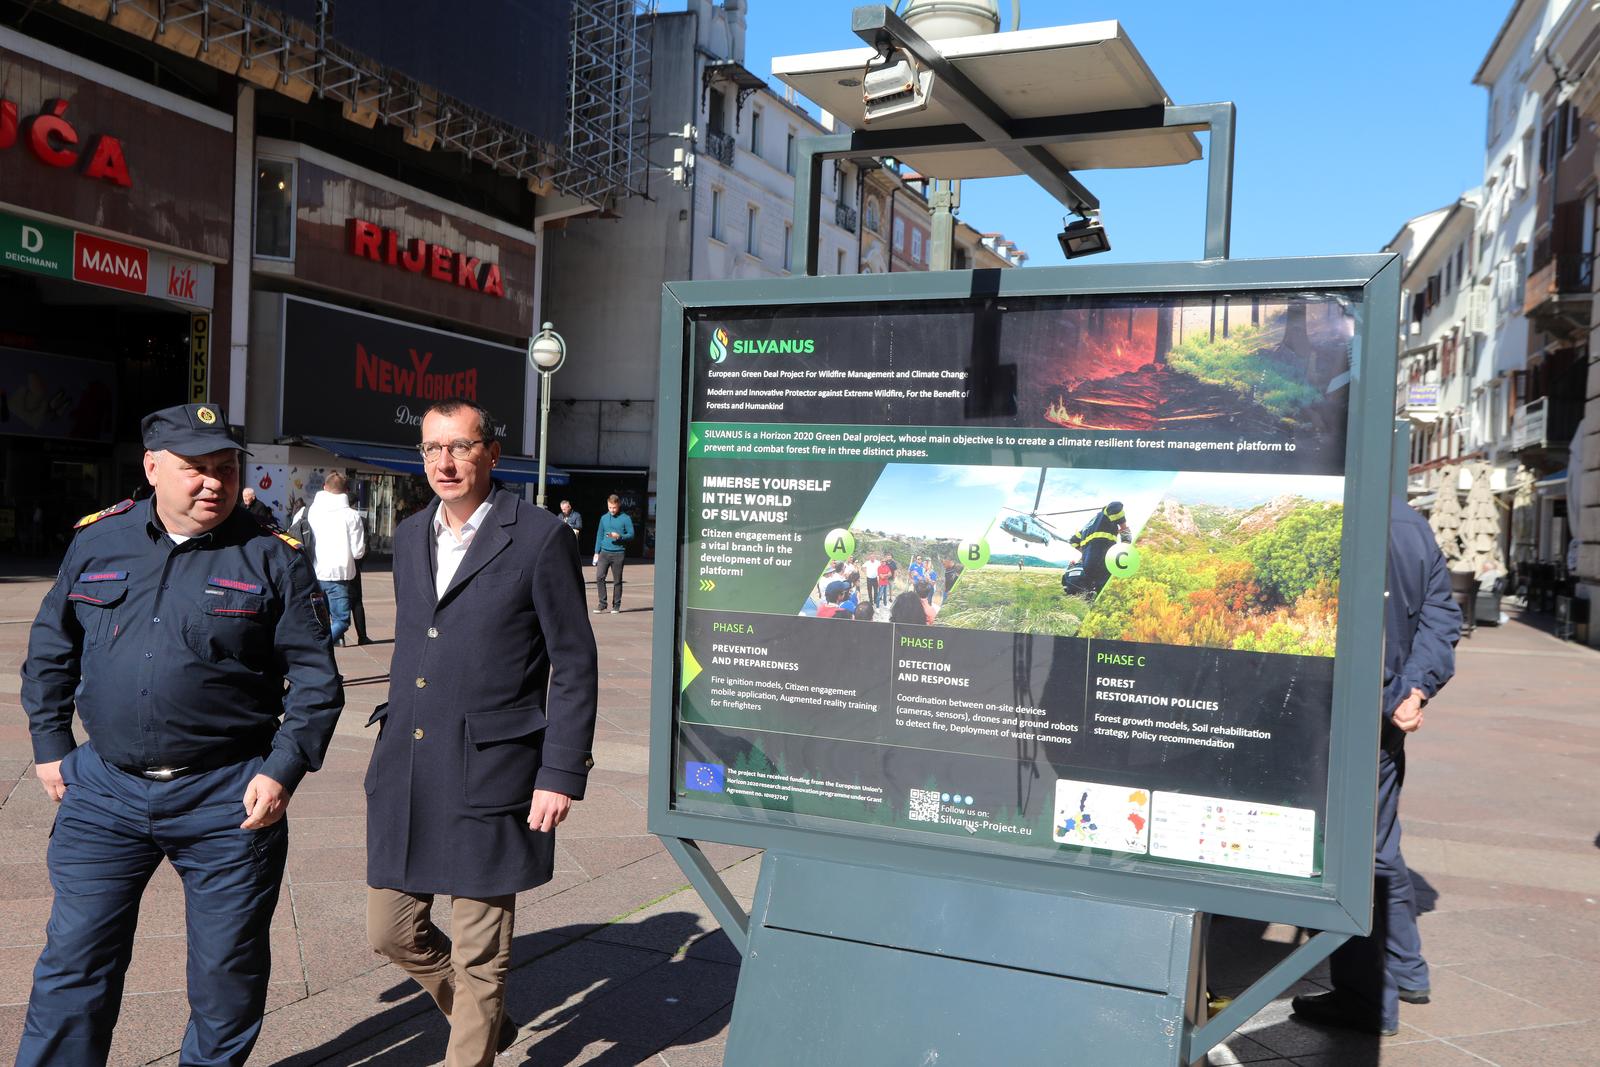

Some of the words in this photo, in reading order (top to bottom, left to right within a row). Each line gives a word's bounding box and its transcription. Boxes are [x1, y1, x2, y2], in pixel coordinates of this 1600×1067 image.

[22, 225, 43, 253] D
[6, 252, 58, 269] DEICHMANN
[82, 248, 142, 280] MANA
[345, 218, 505, 298] RIJEKA
[733, 339, 814, 354] SILVANUS
[193, 318, 207, 399] OTKUP
[708, 370, 740, 378] European
[764, 370, 778, 378] Deal
[780, 370, 804, 379] Project
[848, 371, 894, 380] Management
[941, 371, 968, 380] Change
[707, 388, 734, 396] Modern
[818, 390, 842, 398] against
[874, 390, 904, 398] Wildfire,
[906, 390, 918, 398] For
[920, 390, 932, 398] the
[934, 390, 960, 398] Benefit
[961, 390, 969, 398] of
[731, 402, 744, 410] and
[745, 402, 783, 410] Humankind
[704, 430, 742, 439] SILVANUS
[744, 431, 751, 439] is
[760, 431, 792, 440] Horizon
[794, 432, 814, 440] 2020
[816, 432, 840, 441] Green
[843, 432, 862, 441] Deal
[864, 432, 896, 443] project,
[899, 434, 926, 443] whose
[929, 434, 950, 444] main
[953, 435, 993, 446] objective
[996, 436, 1003, 445] is
[1005, 437, 1015, 445] to
[1018, 437, 1047, 446] create
[1057, 437, 1092, 447] climate
[1094, 438, 1133, 448] resilient
[1136, 439, 1164, 449] forest
[1167, 441, 1234, 451] management
[1236, 440, 1282, 452] platform
[1284, 442, 1296, 451] to
[704, 444, 734, 453] prevent
[737, 444, 751, 452] and
[754, 444, 783, 452] combat
[786, 445, 809, 453] forest
[812, 445, 826, 454] fire
[828, 446, 836, 454] in
[838, 446, 860, 455] three
[863, 447, 893, 456] distinct
[896, 448, 928, 458] phases.
[703, 476, 760, 489] IMMERSE
[762, 478, 831, 491] YOURSELF
[702, 492, 714, 504] IN
[717, 493, 742, 504] THE
[745, 494, 792, 506] WORLD
[702, 509, 719, 519] OF
[721, 510, 788, 522] SILVANUS!
[702, 528, 732, 538] Citizen
[735, 531, 792, 541] engagement
[794, 533, 802, 541] is
[709, 541, 729, 550] vital
[732, 541, 763, 552] branch
[766, 544, 774, 552] in
[777, 545, 792, 554] the
[833, 537, 846, 553] A
[701, 553, 761, 565] development
[763, 557, 773, 565] of
[968, 544, 981, 561] B
[1115, 552, 1129, 570] C
[701, 566, 743, 576] platform!
[713, 623, 744, 634] PHASE
[747, 625, 754, 634] A
[712, 644, 768, 655] PREVENTION
[901, 637, 933, 649] PHASE
[937, 640, 944, 649] B
[712, 657, 731, 665] AND
[734, 658, 799, 671] PREPAREDNESS
[899, 660, 951, 672] DETECTION
[1098, 653, 1134, 665] PHASE
[1138, 656, 1146, 666] C
[712, 676, 724, 684] Fire
[727, 678, 753, 687] ignition
[755, 681, 783, 690] models,
[785, 683, 809, 692] Citizen
[811, 686, 856, 697] engagement
[898, 673, 918, 682] AND
[921, 675, 970, 687] RESPONSE
[1097, 677, 1135, 688] FOREST
[711, 688, 735, 696] mobile
[737, 690, 778, 702] application,
[780, 694, 822, 706] Augmented
[824, 698, 846, 709] reality
[848, 701, 877, 712] training
[711, 699, 721, 707] for
[723, 700, 761, 711] firefighters
[897, 694, 947, 705] Coordination
[949, 700, 983, 710] between
[986, 703, 1014, 713] on-site
[1016, 706, 1046, 716] devices
[1096, 691, 1168, 706] RESTORATION
[1171, 698, 1219, 711] POLICIES
[897, 706, 934, 718] (cameras,
[936, 710, 970, 722] sensors),
[972, 714, 1000, 723] drones
[1002, 717, 1017, 726] and
[1019, 719, 1049, 729] ground
[1051, 722, 1078, 732] robots
[906, 719, 930, 729] detect
[932, 722, 948, 732] fire,
[950, 724, 998, 737] Deployment
[1001, 729, 1010, 737] of
[1011, 731, 1034, 740] water
[1037, 734, 1071, 744] cannons
[1095, 714, 1121, 724] Forest
[1123, 717, 1153, 727] growth
[1156, 720, 1190, 732] models,
[1192, 723, 1208, 733] Soil
[1210, 725, 1271, 739] rehabilitation
[1094, 728, 1130, 739] strategy,
[1132, 730, 1157, 741] Policy
[1159, 734, 1234, 749] recommendation
[790, 776, 810, 785] funding
[836, 782, 861, 790] European
[819, 790, 849, 798] programme
[941, 805, 964, 814] Follow
[941, 815, 1032, 835] Silvanus-Project.eu
